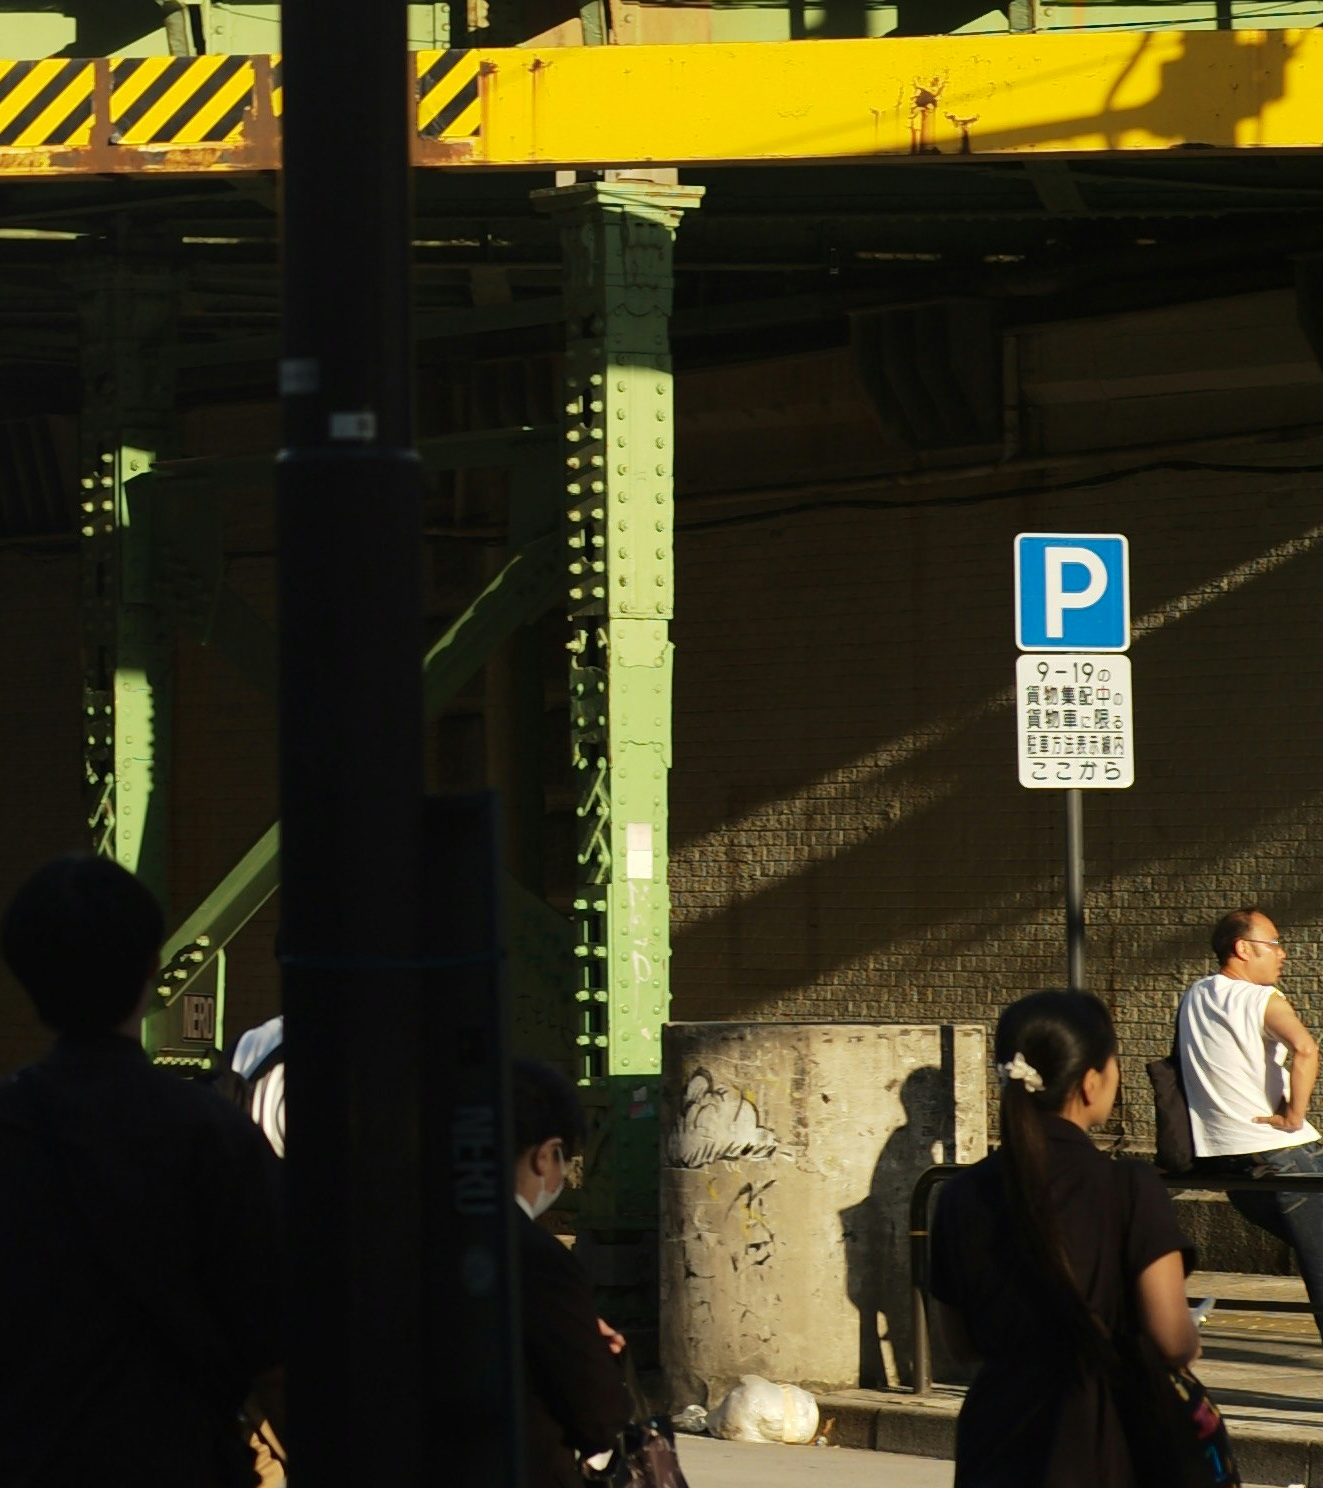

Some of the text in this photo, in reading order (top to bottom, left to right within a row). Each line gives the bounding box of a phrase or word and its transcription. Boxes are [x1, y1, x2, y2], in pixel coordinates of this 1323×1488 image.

[1044, 545, 1109, 640] P
[1031, 760, 1122, 781] ここから
